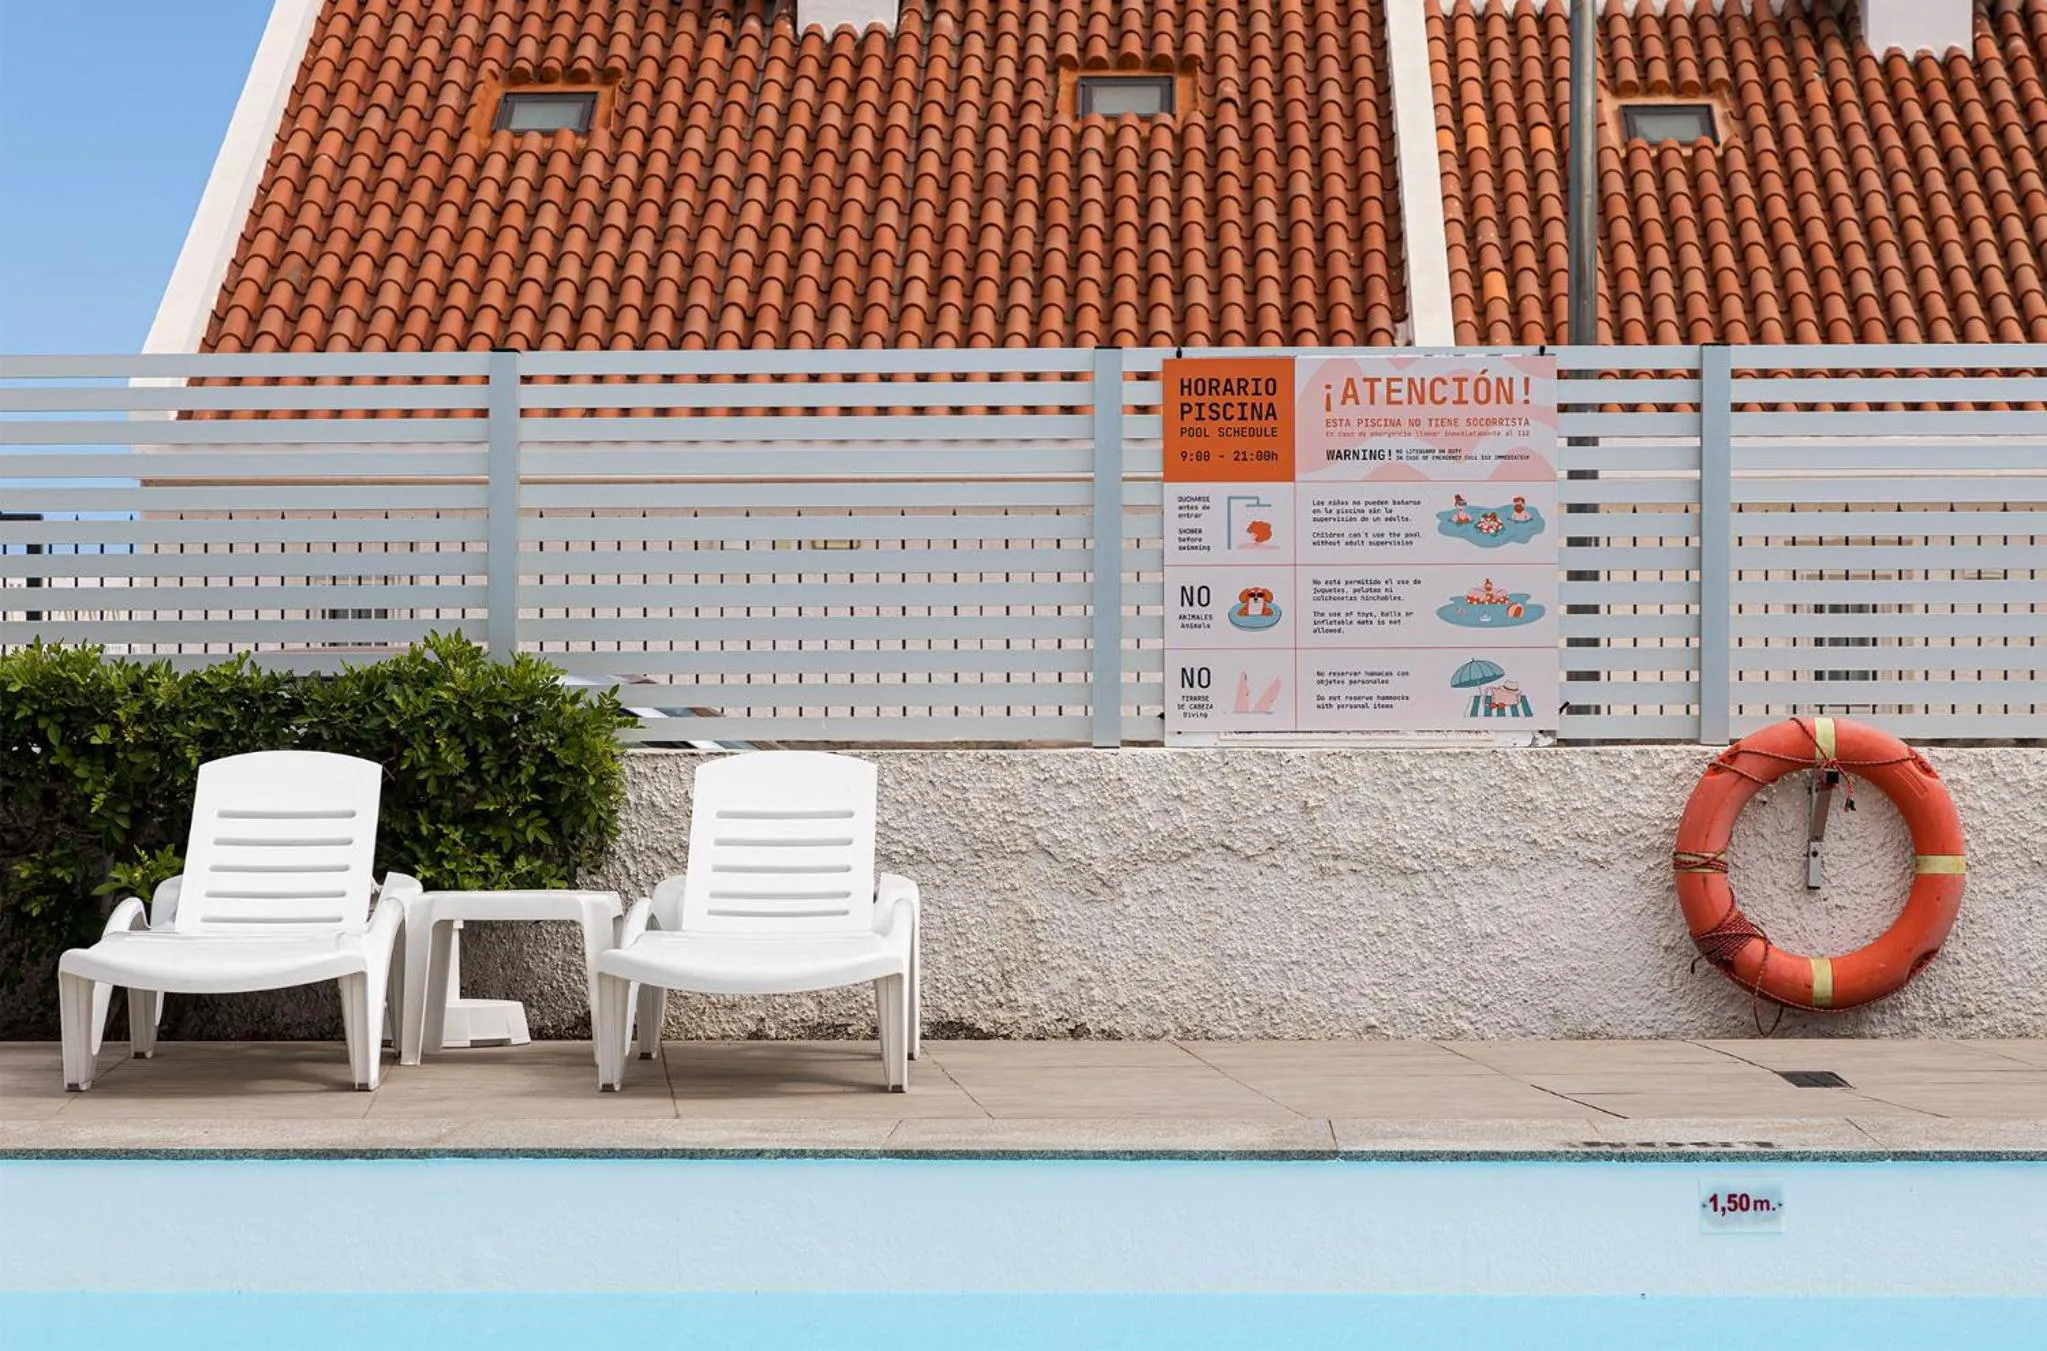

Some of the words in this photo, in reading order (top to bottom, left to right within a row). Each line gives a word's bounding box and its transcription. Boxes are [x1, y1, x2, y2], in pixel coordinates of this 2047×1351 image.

[1180, 378, 1277, 396] HORARIO
[1324, 368, 1530, 412] ¡ATENCIÓN!
[1180, 402, 1278, 421] PISCINA
[1325, 418, 1351, 428] ESTA
[1357, 418, 1402, 428] PISCINA
[1408, 418, 1421, 428] NO
[1428, 418, 1459, 428] TIENE
[1466, 417, 1530, 427] SOCORRISTA
[1180, 427, 1210, 438] POOL
[1218, 427, 1278, 438] SCHEDULE
[1181, 450, 1210, 462] 9:00
[1233, 450, 1278, 462] 21:00h
[1326, 449, 1392, 461] WARNING!
[1180, 585, 1211, 608] NO
[1178, 613, 1213, 621] ANIMALES
[1181, 667, 1212, 689] NO
[1182, 711, 1209, 719] Diving
